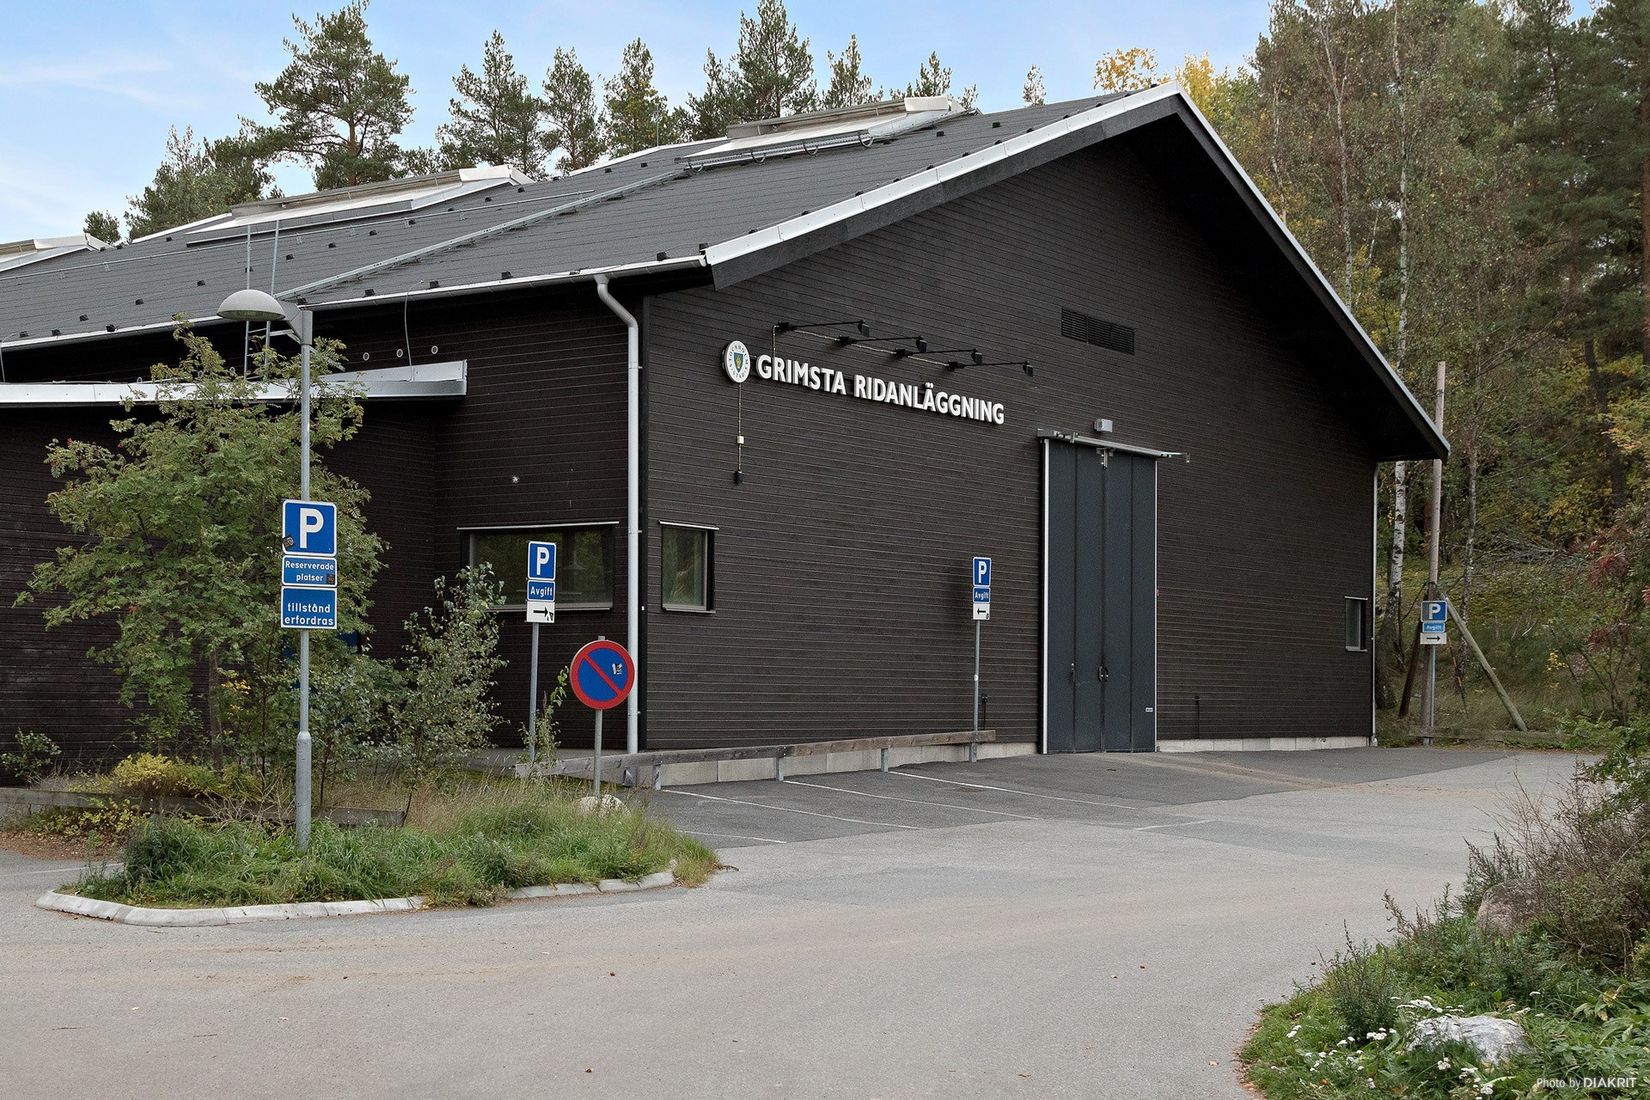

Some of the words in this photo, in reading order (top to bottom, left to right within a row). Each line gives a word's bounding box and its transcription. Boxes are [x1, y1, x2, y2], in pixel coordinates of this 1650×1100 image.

[757, 354, 847, 395] GRIMSTA
[854, 374, 1005, 425] RIDANLÄGGNING
[299, 507, 324, 549] P
[285, 560, 335, 572] Reserverade
[536, 546, 550, 576] P
[296, 573, 324, 583] platser
[978, 560, 987, 584] P
[530, 586, 553, 598] Avgift
[974, 591, 989, 601] Avgift
[287, 602, 331, 614] tillstånd
[1429, 603, 1441, 620] P
[284, 615, 334, 626] erfordras
